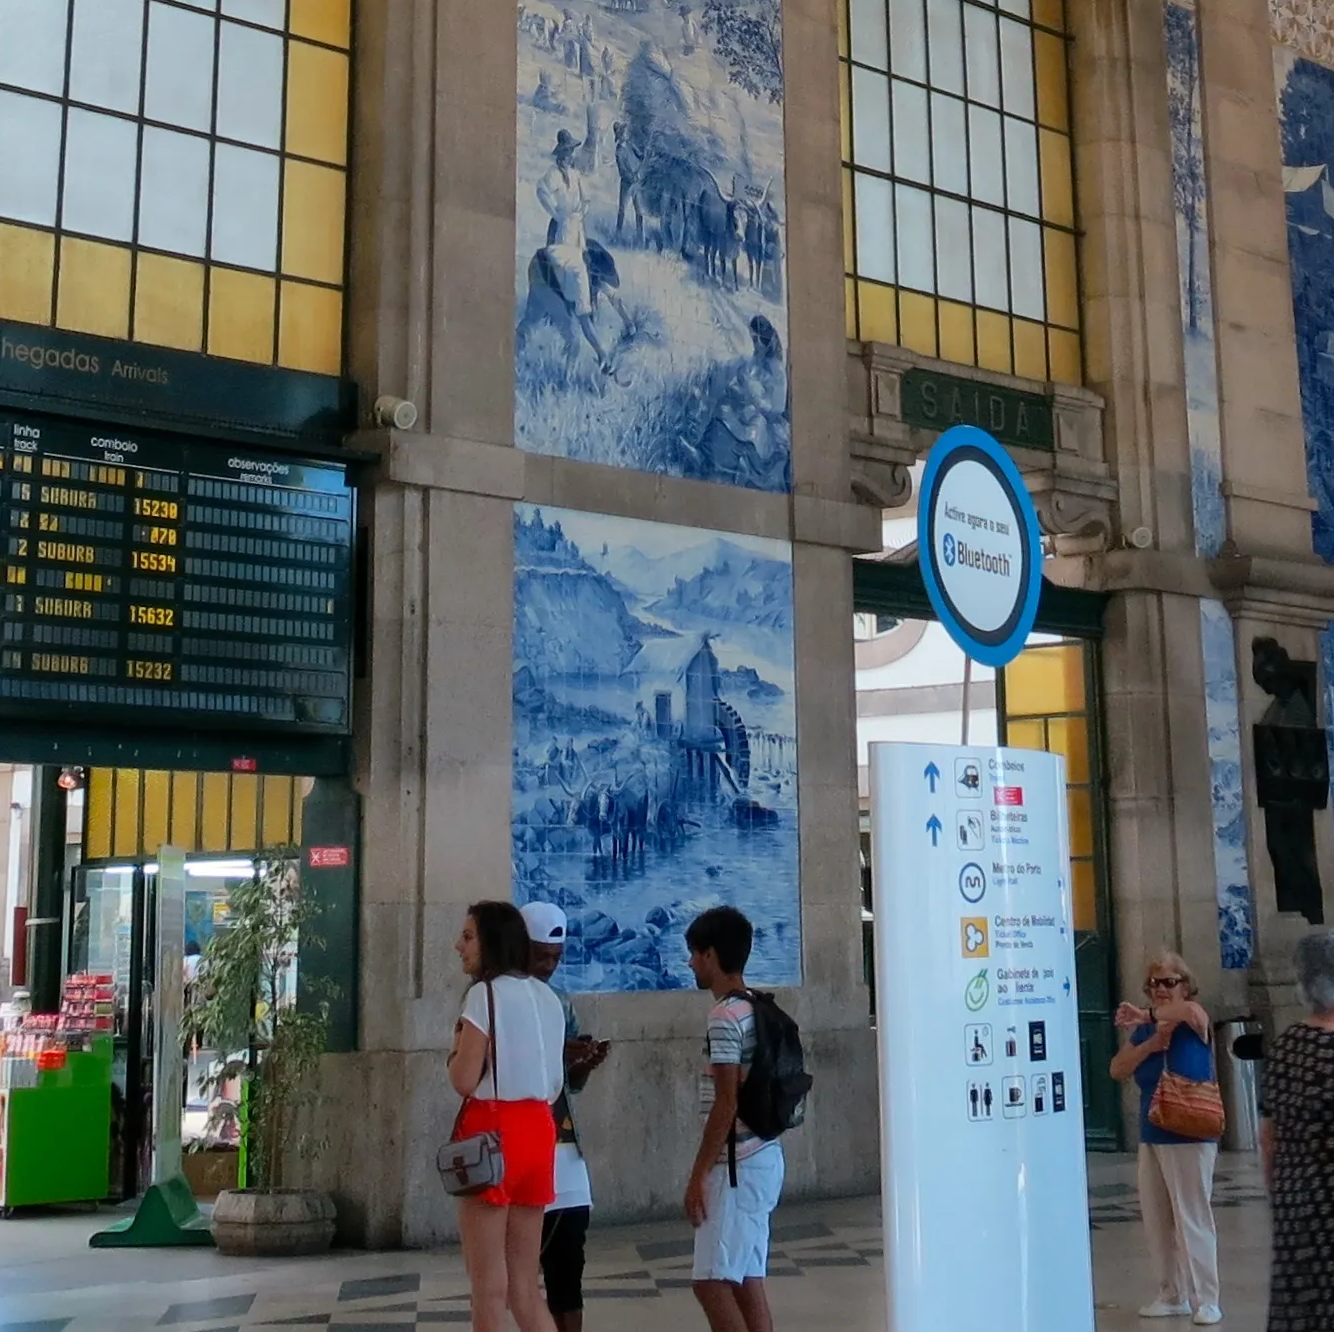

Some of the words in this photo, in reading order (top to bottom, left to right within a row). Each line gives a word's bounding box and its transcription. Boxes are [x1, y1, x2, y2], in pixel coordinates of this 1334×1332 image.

[112, 360, 169, 384] Arrivals
[14, 424, 40, 438] linha
[14, 438, 38, 451] track
[91, 436, 138, 453] comboio
[104, 450, 124, 463] train
[228, 457, 289, 475] observações
[18, 538, 28, 557] 2
[37, 541, 94, 563] SUBURB
[131, 551, 176, 572] 15534
[958, 540, 1010, 577] Bluetooth
[129, 605, 174, 626] 15632
[126, 659, 172, 680] 15232
